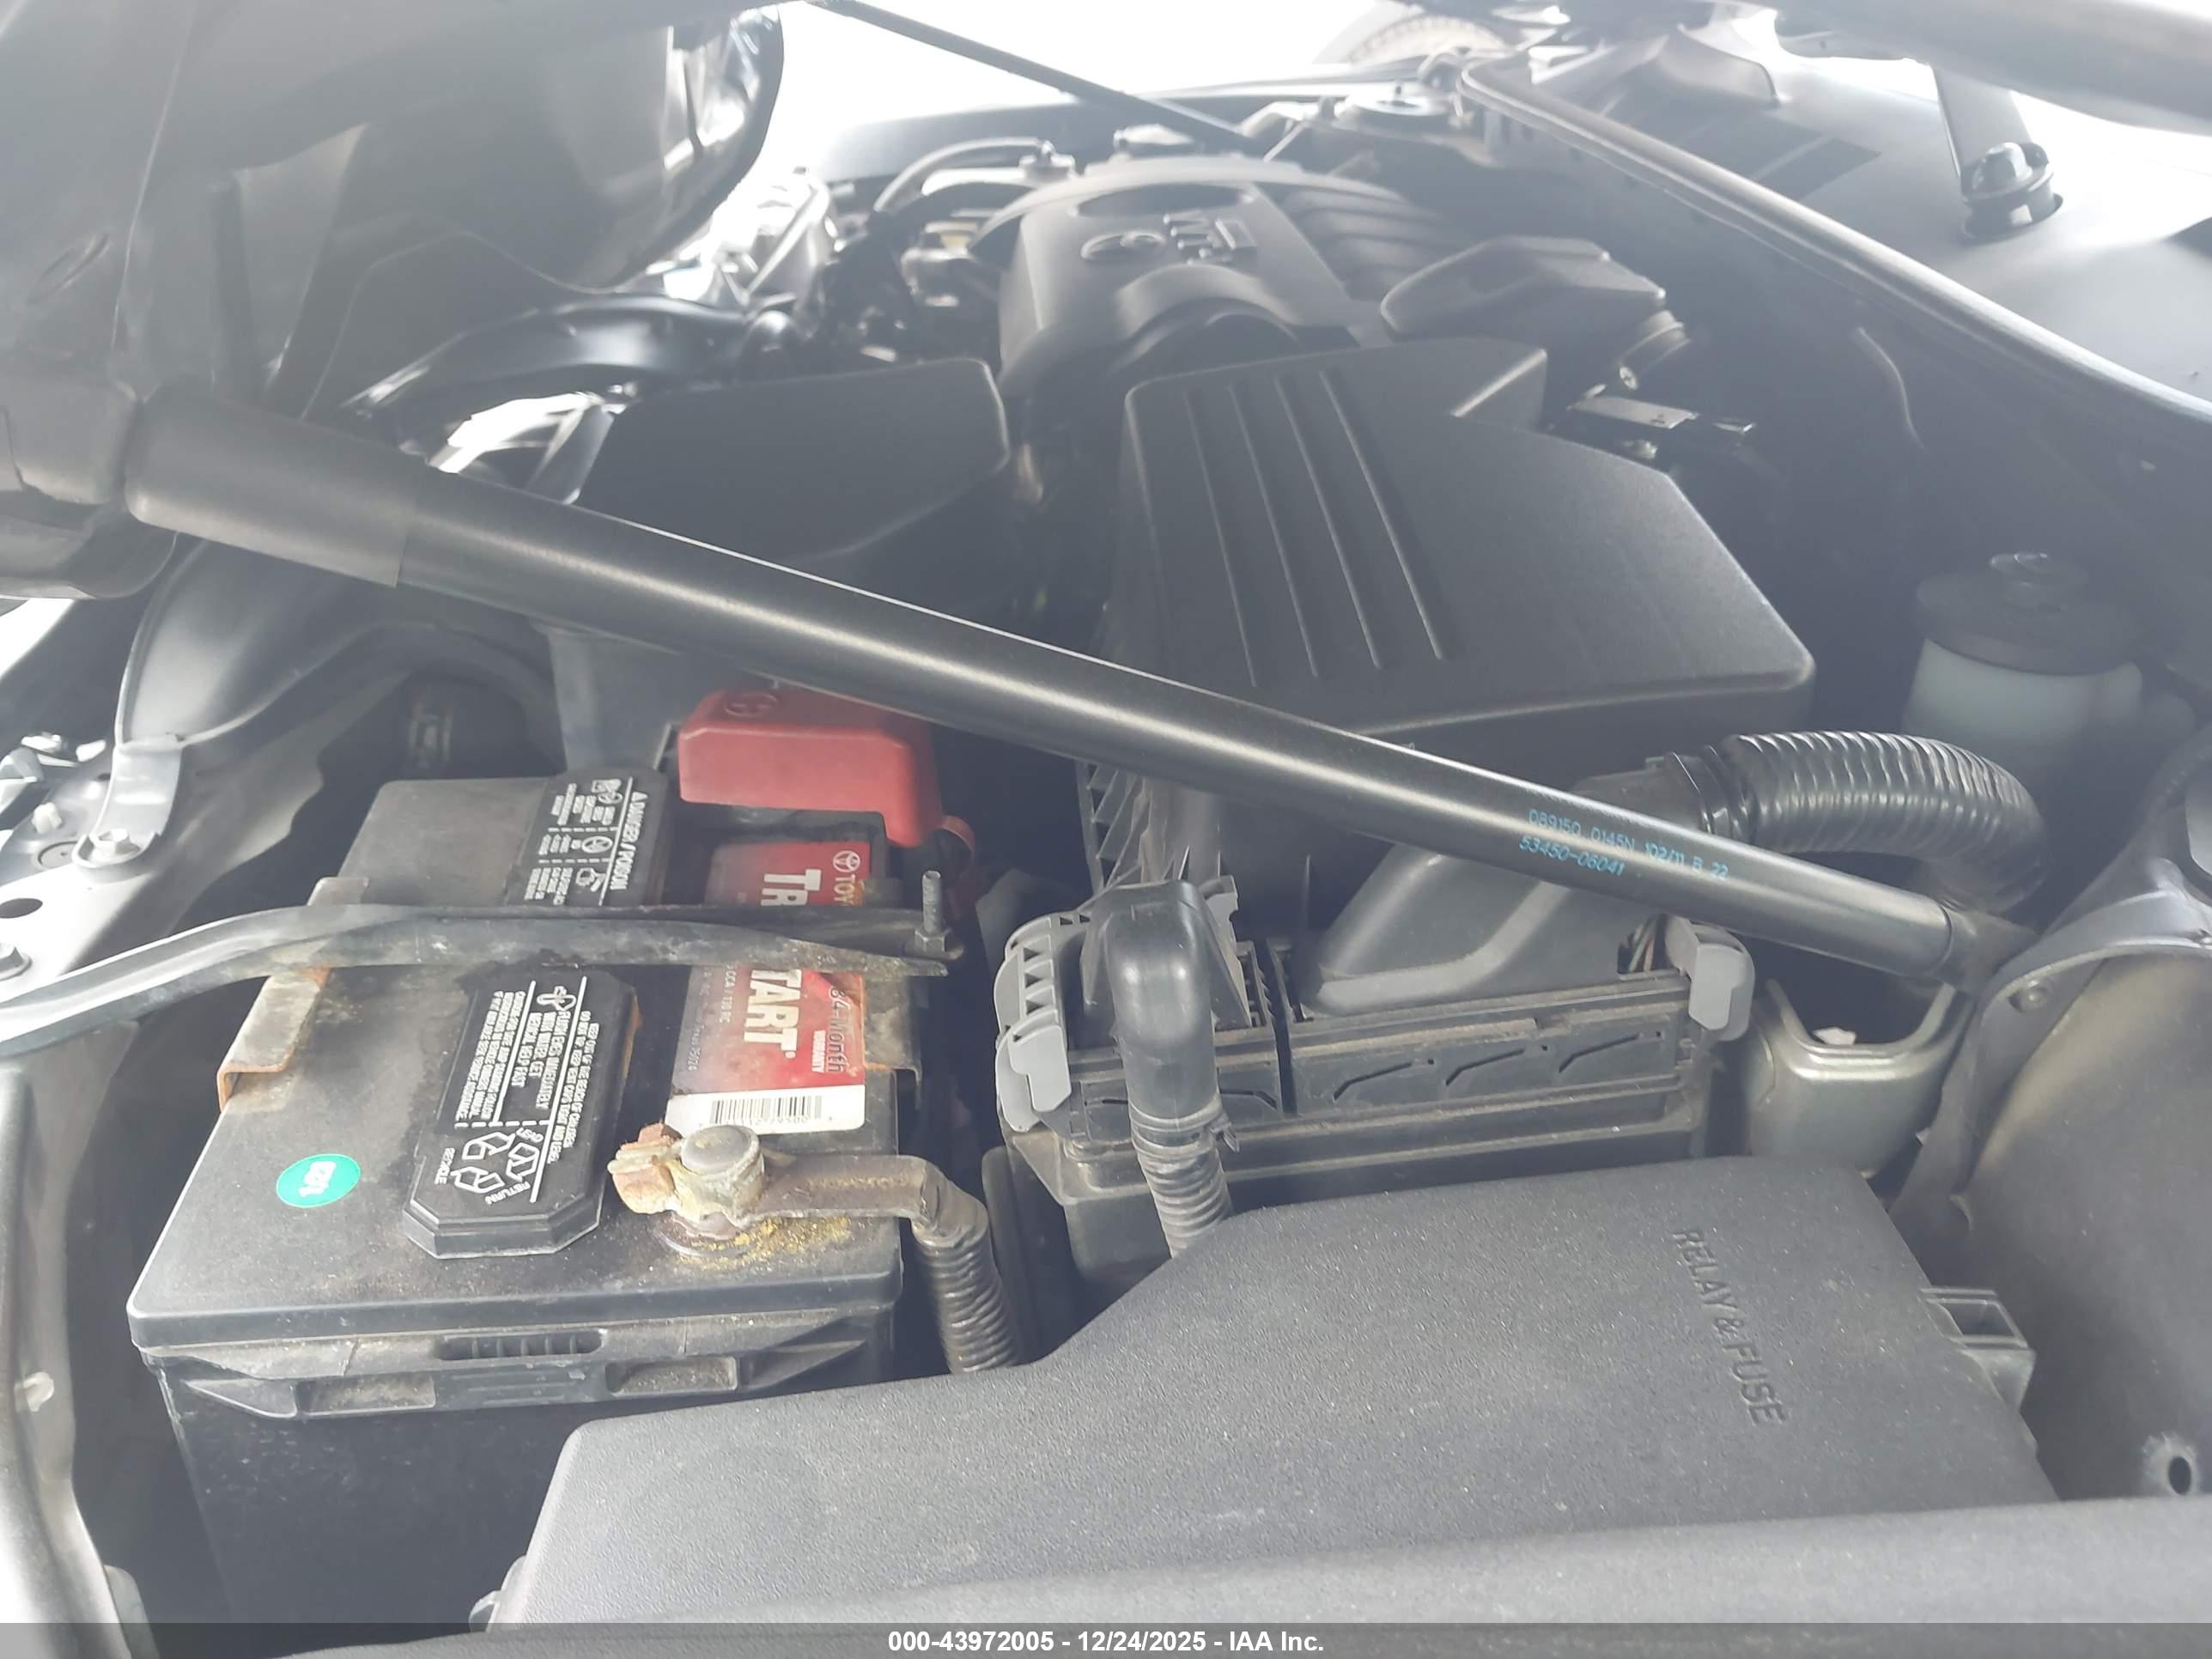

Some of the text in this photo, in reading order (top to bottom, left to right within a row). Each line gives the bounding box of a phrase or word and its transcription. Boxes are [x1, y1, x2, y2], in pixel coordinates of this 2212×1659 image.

[622, 801, 646, 843] DANGER
[610, 851, 635, 890] POISON
[811, 1030, 826, 1073] WARRANTY
[484, 1181, 532, 1205] RETURN
[1673, 1230, 1787, 1426] RELAY & FUSE
